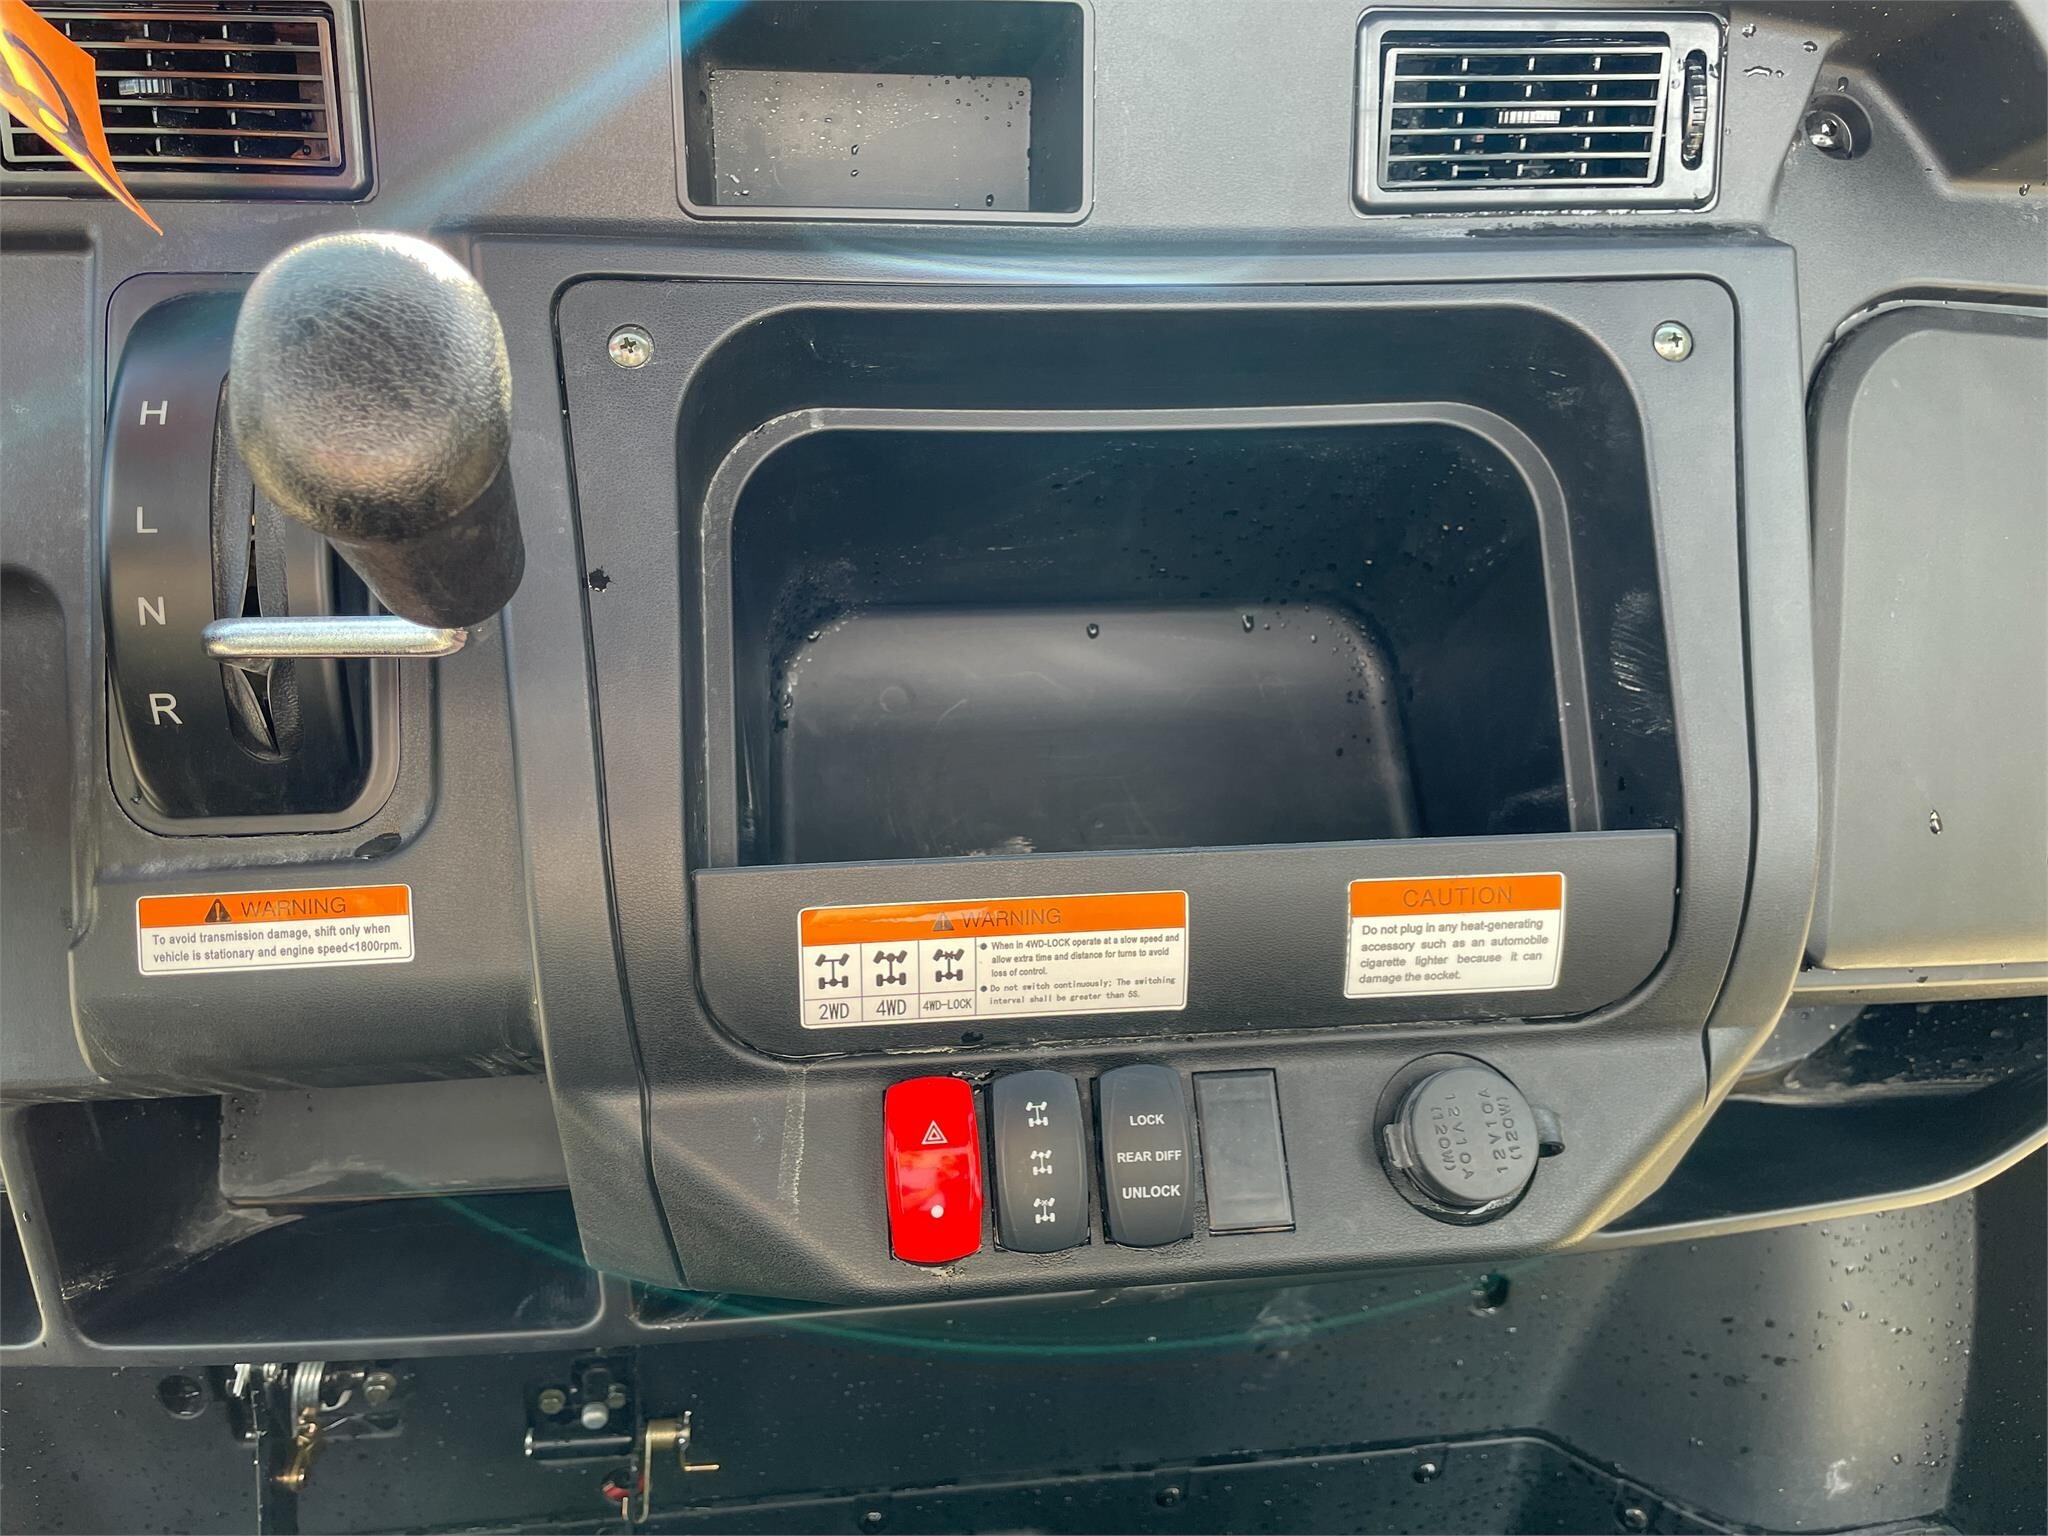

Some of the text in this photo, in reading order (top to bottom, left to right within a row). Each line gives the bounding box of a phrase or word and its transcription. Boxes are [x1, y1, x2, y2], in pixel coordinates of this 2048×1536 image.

[139, 401, 168, 425] H
[136, 507, 158, 533] L
[138, 597, 166, 625] N
[149, 693, 183, 725] R
[1403, 886, 1512, 908] CAUTION
[241, 896, 346, 918] WARNING
[961, 907, 1061, 928] WARNING
[152, 924, 391, 945] To avoid transmission damage, shift only when
[1362, 919, 1544, 936] Do not plug in any heat-generating
[991, 941, 1014, 950] When
[1016, 941, 1024, 949] in
[1025, 938, 1070, 949] 4WD-LOCK
[1072, 937, 1101, 948] operate
[1104, 937, 1112, 945] at
[1120, 935, 1137, 944] slow
[1140, 934, 1163, 945] speed
[1165, 934, 1179, 942] and
[1361, 935, 1549, 952] accessory such as an automobile
[153, 951, 189, 963] vehicle
[192, 949, 201, 960] is
[204, 947, 254, 961] stationary
[258, 946, 276, 957] and
[280, 945, 314, 958] engine
[992, 947, 1169, 964] allow extra time and distance for turns to avoid
[1360, 952, 1542, 969] cigarette lighter because it can
[991, 967, 1047, 977] loss of control.
[1359, 970, 1461, 985] damage the socket.
[990, 984, 1000, 992] Do
[1022, 981, 1050, 990] switch
[1117, 978, 1131, 986] The
[1135, 976, 1176, 987] switching
[923, 998, 972, 1011] 4WD-LOCK
[990, 995, 1025, 1005] interval
[1030, 994, 1052, 1003] shall
[1057, 993, 1066, 1001] be
[1070, 991, 1101, 1002] greater
[1106, 990, 1125, 999] than
[819, 1002, 849, 1020] 2WD
[876, 999, 906, 1016] 4WD
[1129, 1114, 1165, 1126] LOCK
[1117, 1150, 1182, 1163] REAR DIFF
[1122, 1185, 1181, 1200] UNLOCK
